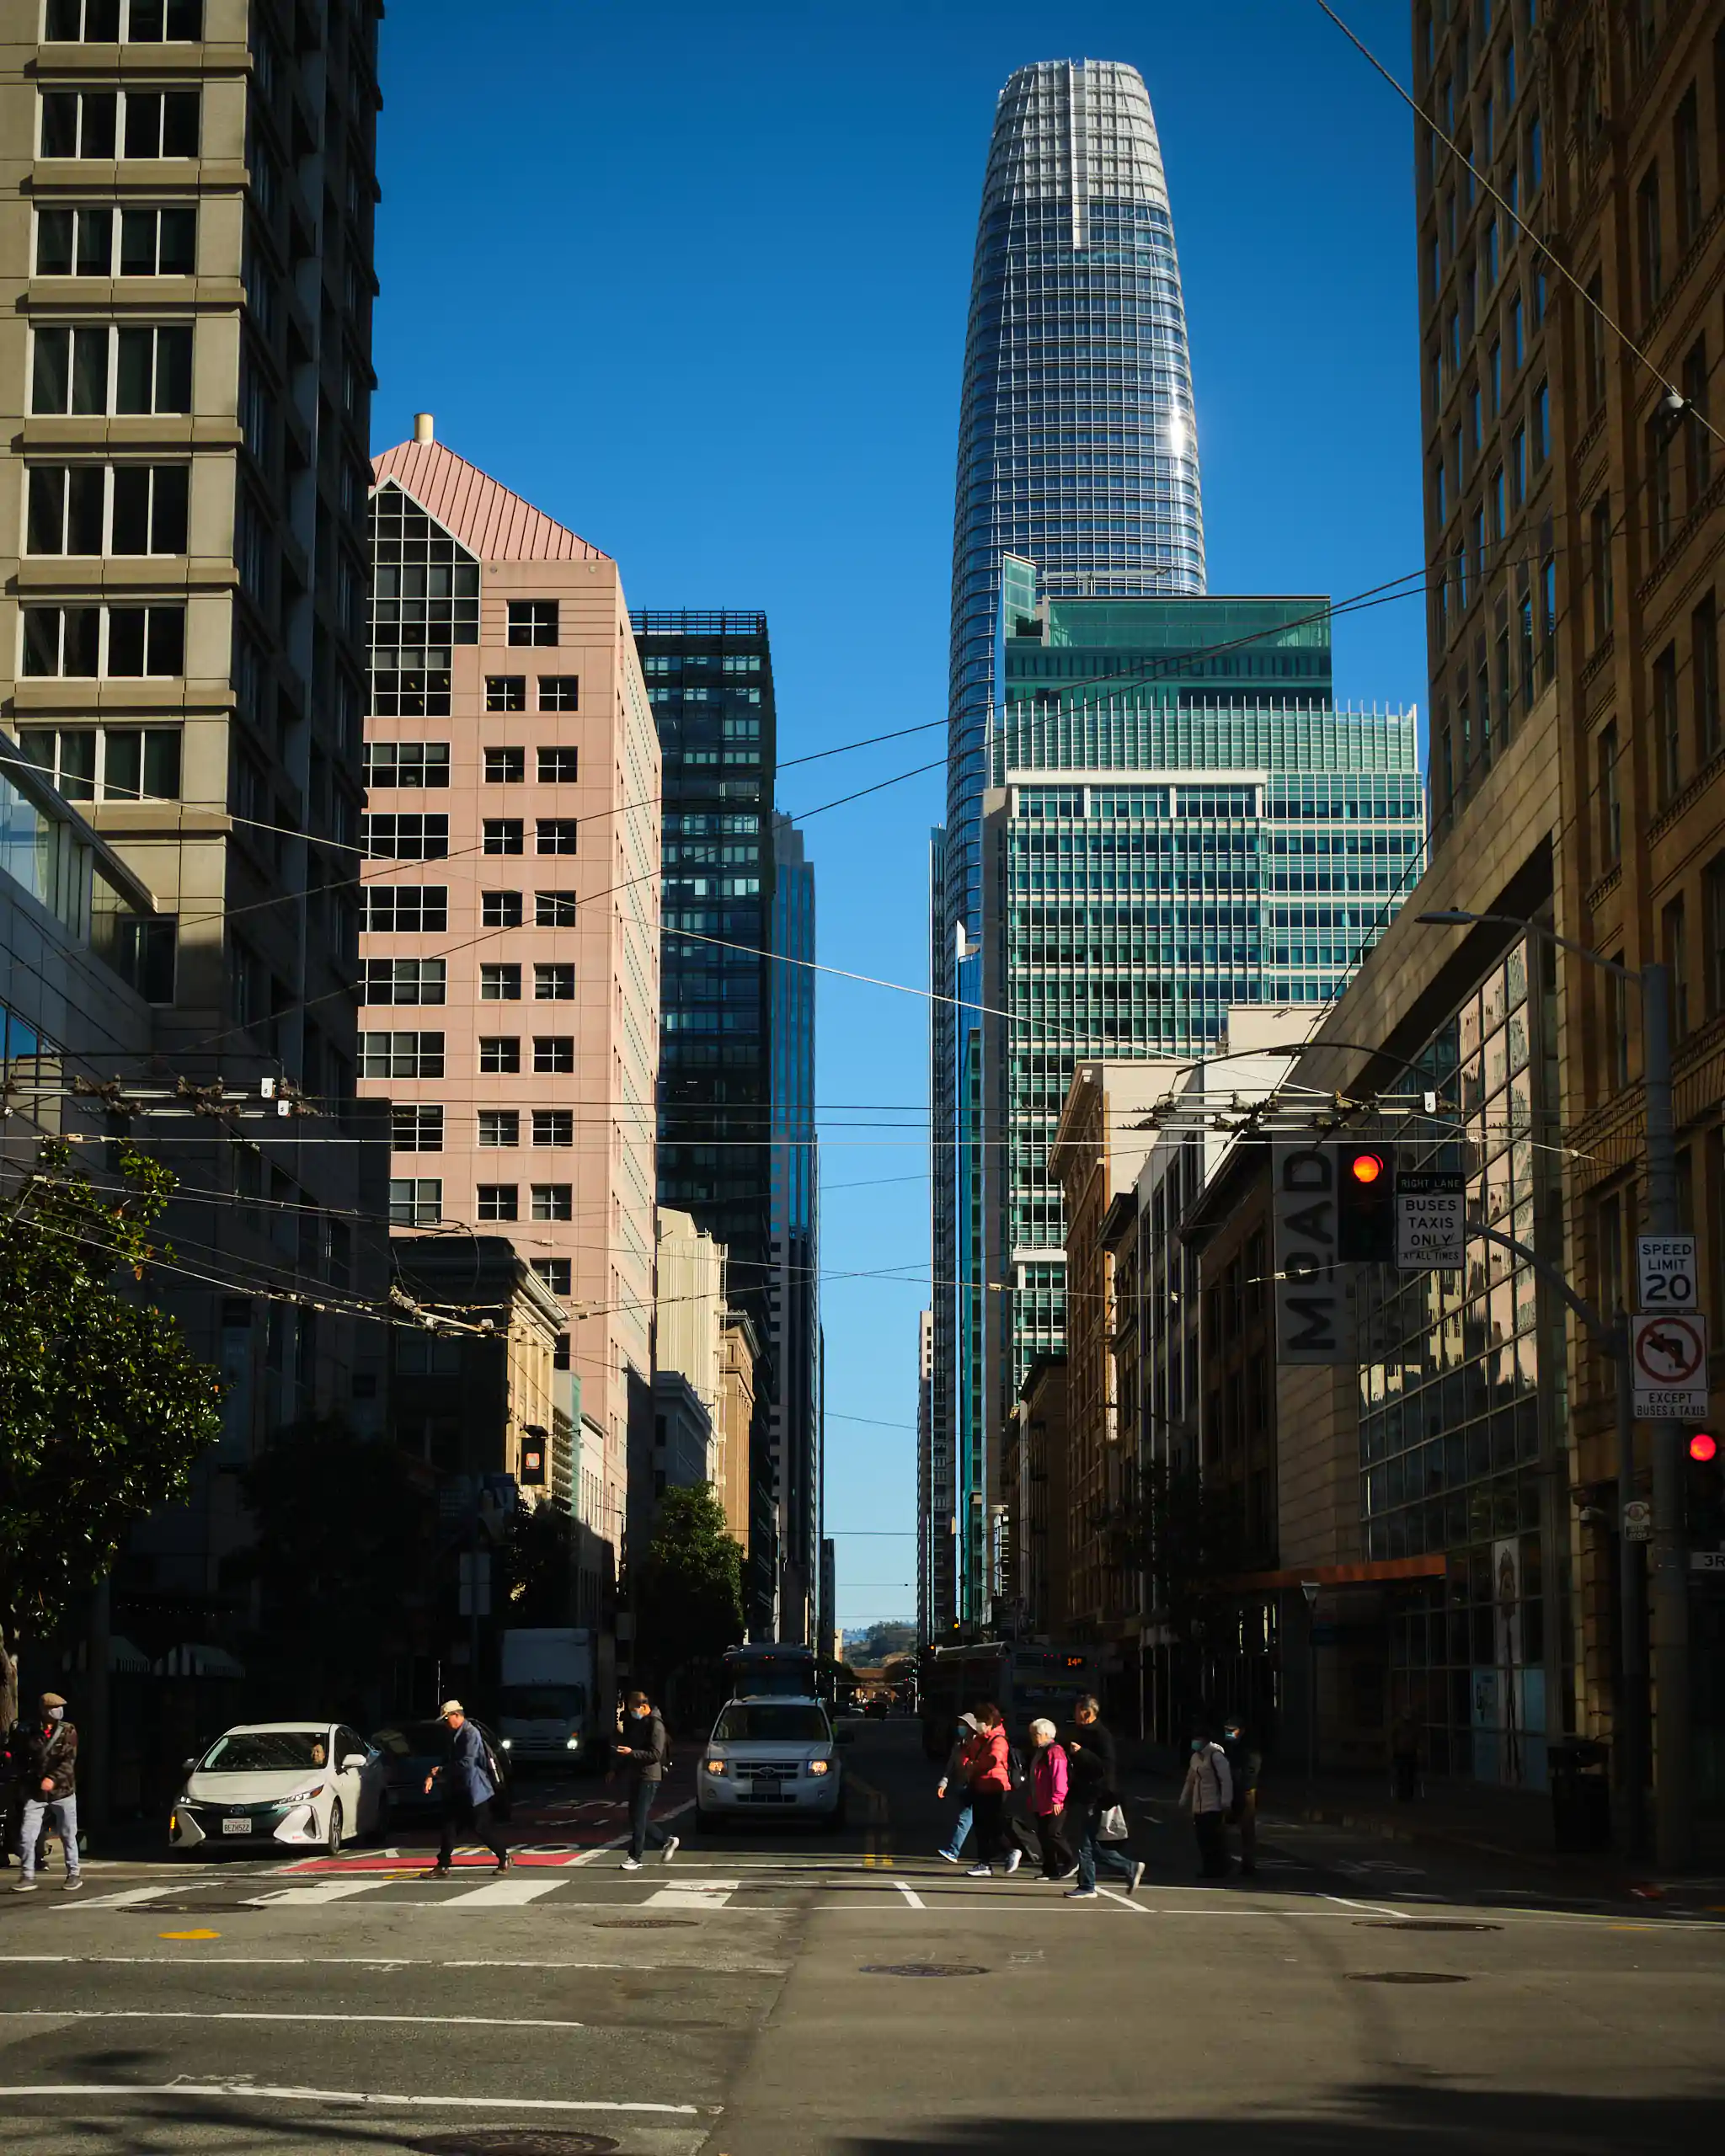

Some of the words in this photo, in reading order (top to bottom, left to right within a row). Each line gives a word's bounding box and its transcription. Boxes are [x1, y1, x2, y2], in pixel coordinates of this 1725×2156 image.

[1401, 1179, 1429, 1188] RIGHT
[1434, 1179, 1461, 1188] LANE
[1405, 1199, 1456, 1211] BUSES
[1407, 1216, 1454, 1229] TAXIS
[1411, 1234, 1451, 1246] ONLY
[1642, 1244, 1691, 1255] SPEED
[1416, 1251, 1432, 1260] ALL
[1435, 1251, 1459, 1261] TIMES
[1648, 1259, 1686, 1270] LIMIT
[1645, 1274, 1691, 1300] 20
[1649, 1393, 1693, 1404] EXCEPT
[1637, 1405, 1668, 1416] BUSES
[1680, 1405, 1706, 1416] TAXIS
